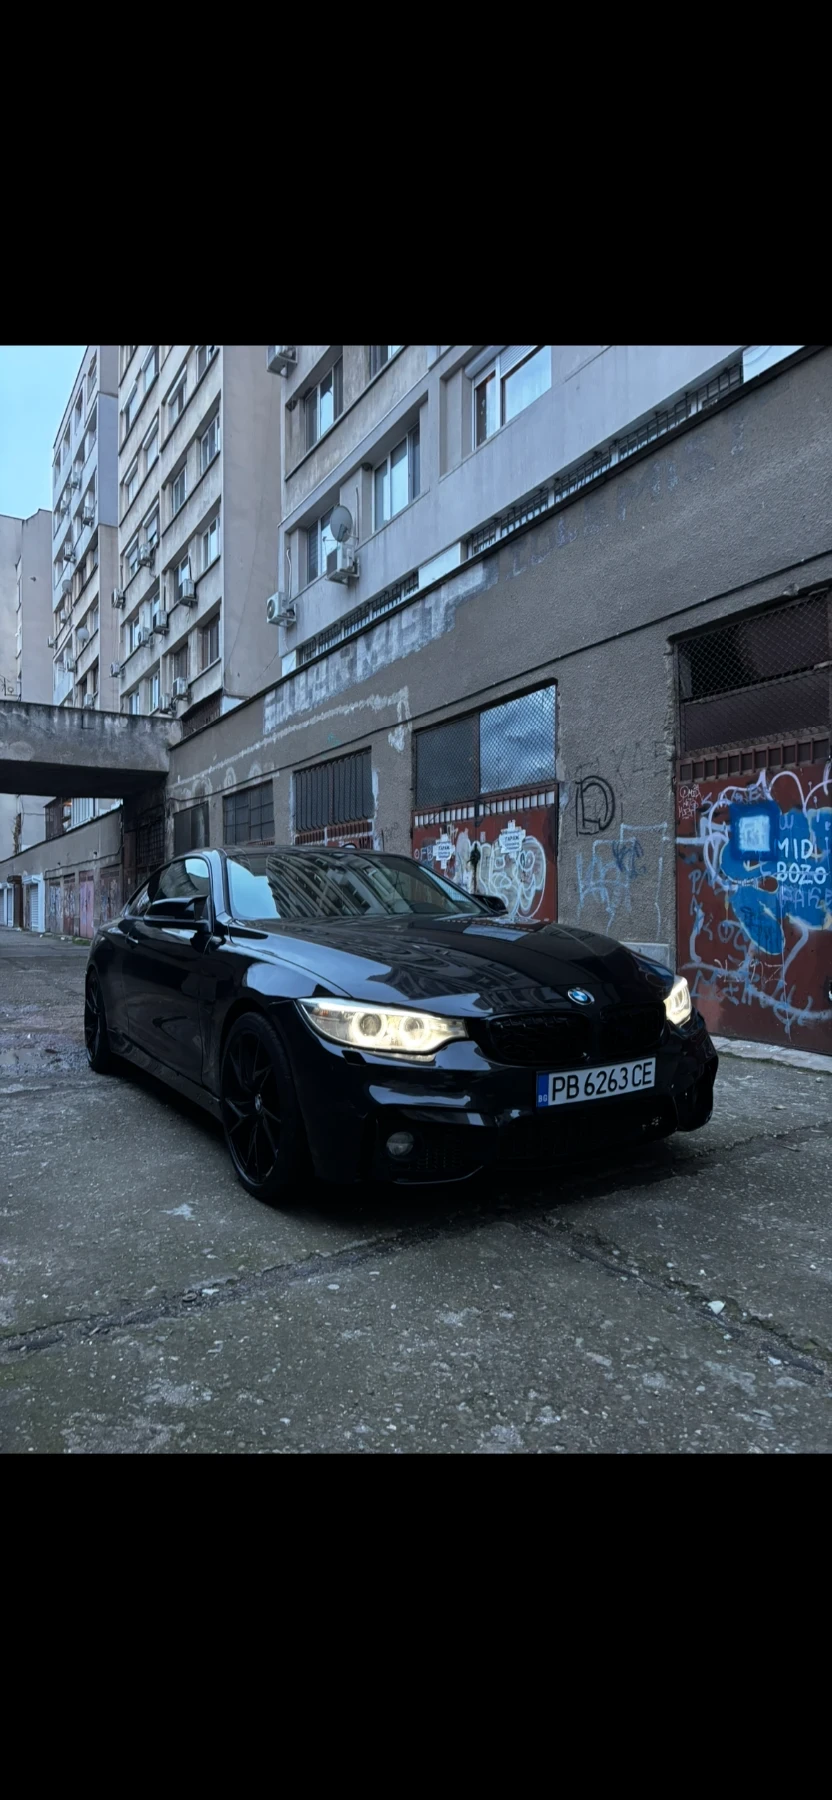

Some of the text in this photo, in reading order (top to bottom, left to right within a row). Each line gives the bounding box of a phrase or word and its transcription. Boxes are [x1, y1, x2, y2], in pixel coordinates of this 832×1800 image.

[777, 837, 814, 861] MID
[776, 861, 828, 885] BOZO
[552, 1062, 652, 1101] PB 6263 CE
[538, 1094, 547, 1103] BG
